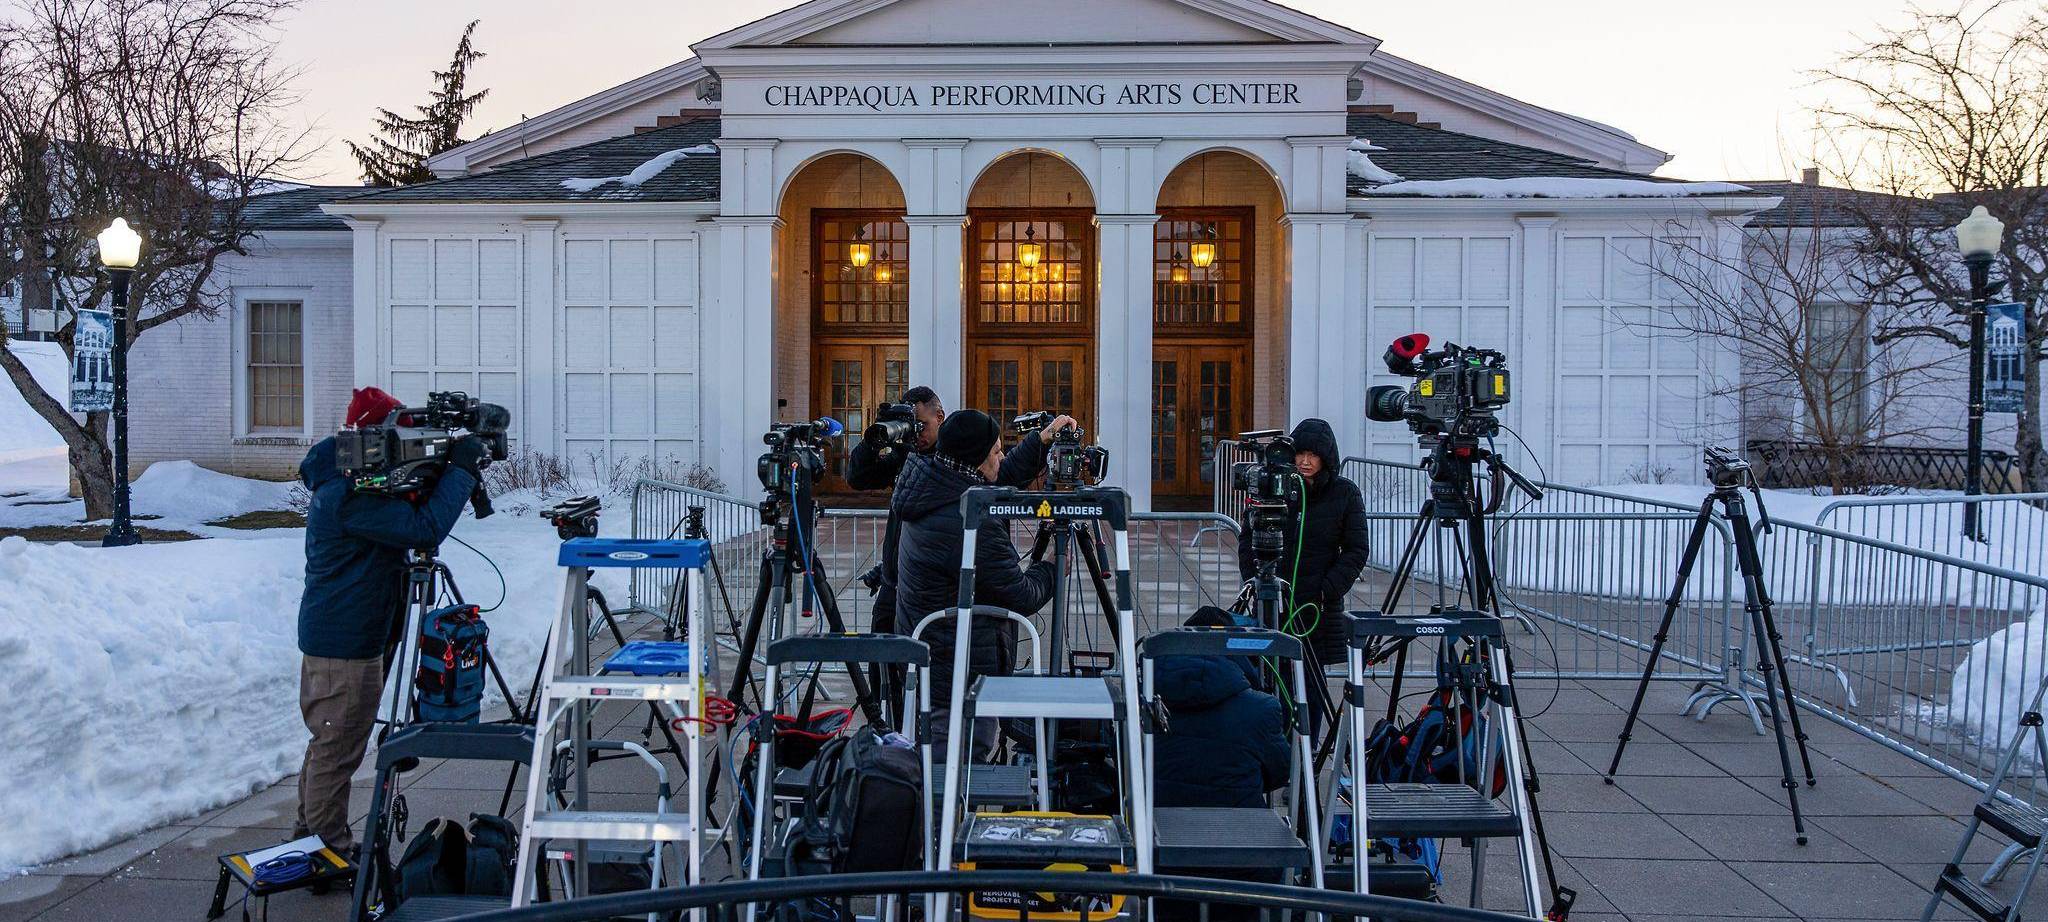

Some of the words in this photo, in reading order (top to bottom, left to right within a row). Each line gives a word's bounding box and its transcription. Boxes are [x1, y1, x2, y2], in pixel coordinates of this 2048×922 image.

[764, 85, 920, 112] CHAPPAQUA
[930, 84, 1106, 106] PERFORMING
[1116, 83, 1182, 105] ARTS
[1192, 83, 1302, 105] CENTER
[989, 506, 1034, 515] GORILLA
[1053, 506, 1103, 516] LADDERS
[1415, 626, 1445, 634] COSCO
